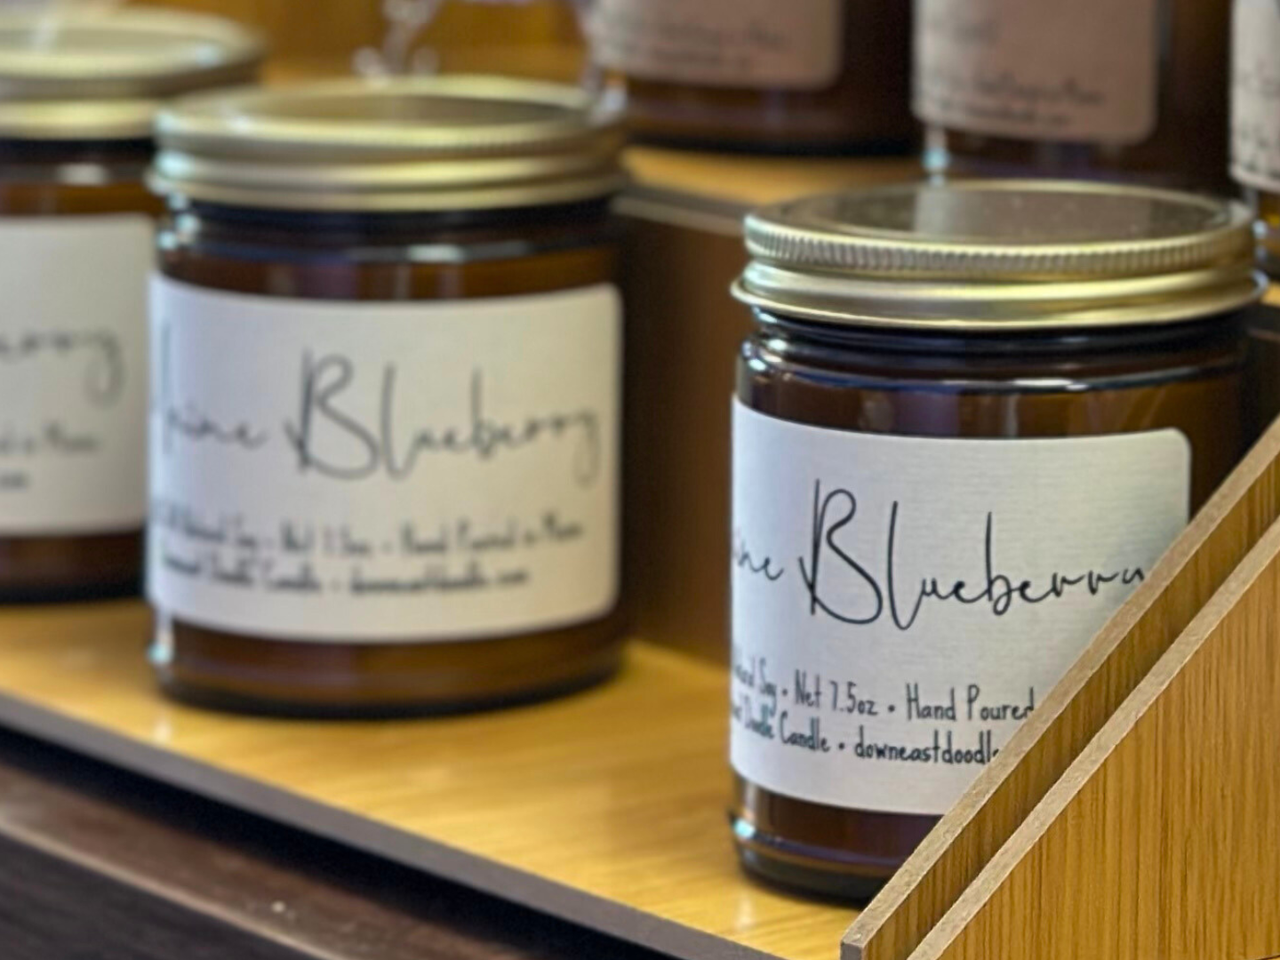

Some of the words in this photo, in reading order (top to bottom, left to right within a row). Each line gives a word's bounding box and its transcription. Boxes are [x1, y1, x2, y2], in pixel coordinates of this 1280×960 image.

[284, 345, 602, 488] Blueberry
[794, 669, 822, 709] Net
[829, 678, 878, 716] 7.5oz
[906, 682, 957, 721] Hand
[780, 710, 831, 753] Candle
